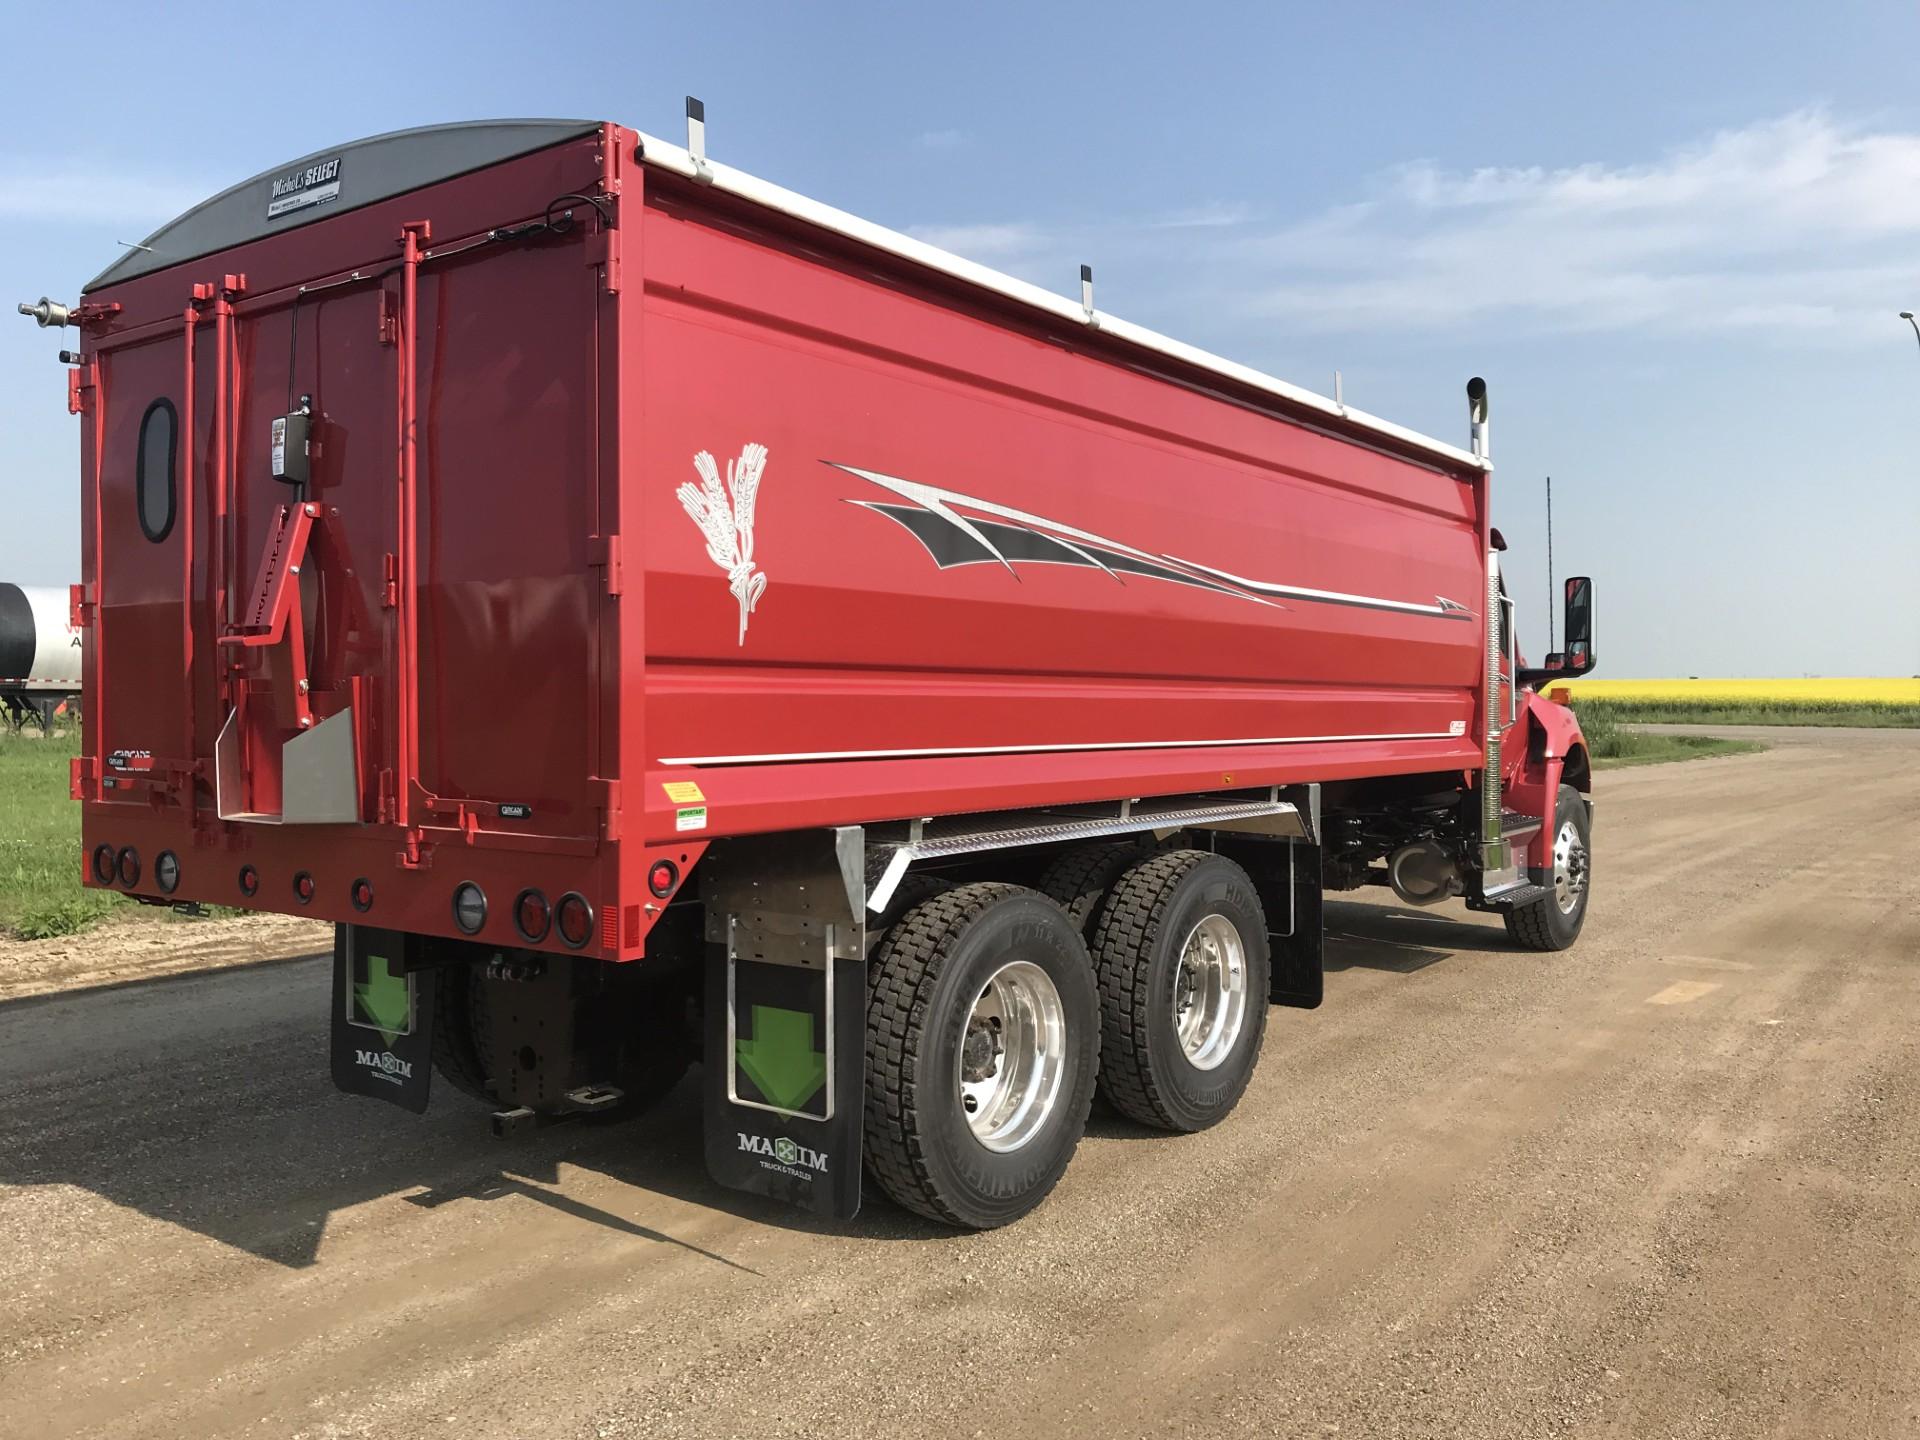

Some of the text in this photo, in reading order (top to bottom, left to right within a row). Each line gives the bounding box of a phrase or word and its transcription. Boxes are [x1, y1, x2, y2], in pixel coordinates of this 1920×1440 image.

[305, 159, 341, 187] SELECT
[737, 1132, 828, 1173] MAXIM
[760, 1161, 782, 1173] TRUCK
[788, 1167, 812, 1182] TRAILER
